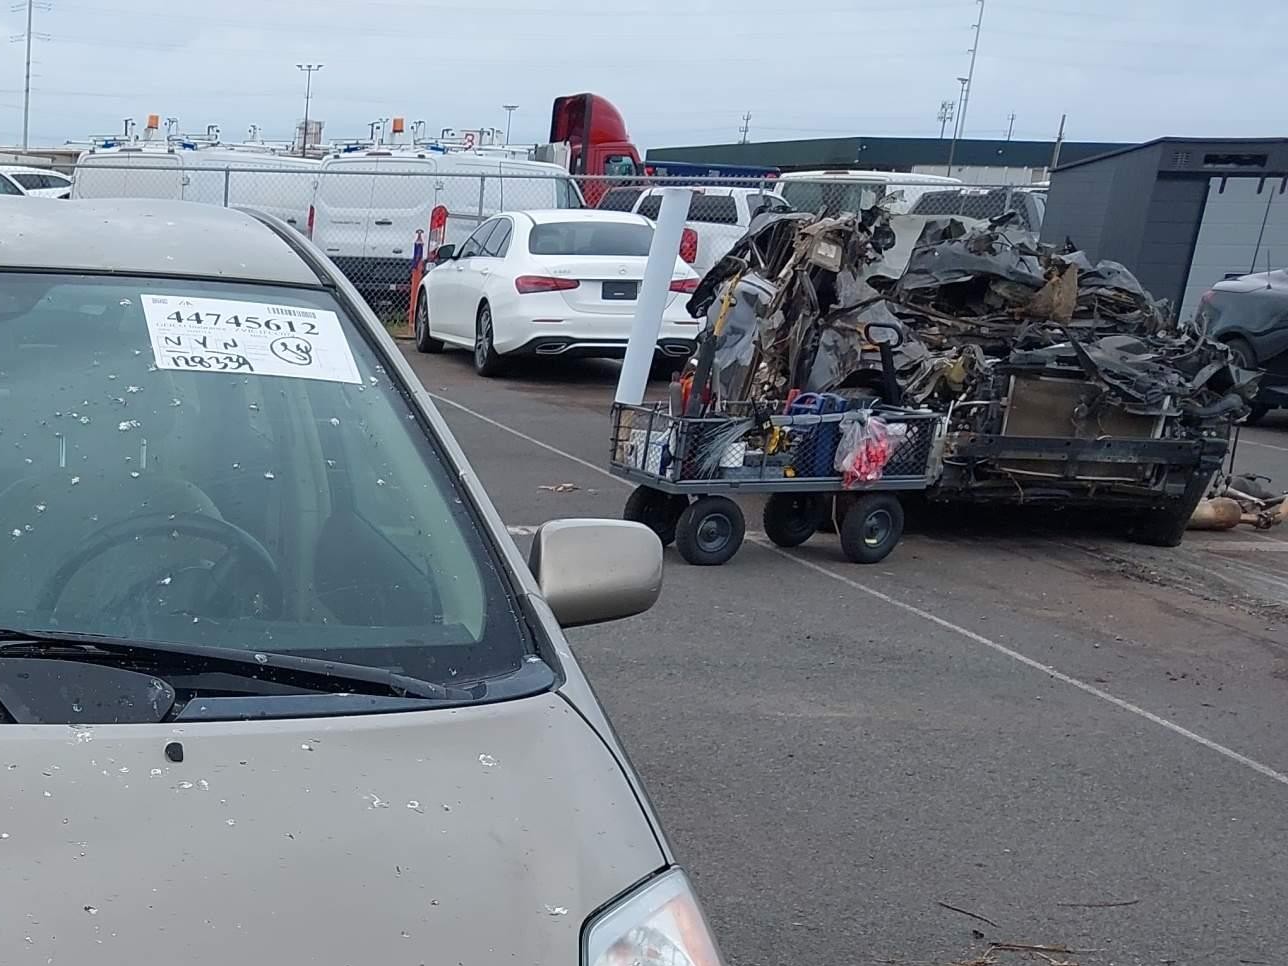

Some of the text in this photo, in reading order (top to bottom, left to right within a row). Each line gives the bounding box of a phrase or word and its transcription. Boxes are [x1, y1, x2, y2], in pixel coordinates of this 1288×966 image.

[167, 310, 319, 336] 44745612
[165, 335, 182, 346] N
[223, 338, 239, 350] N
